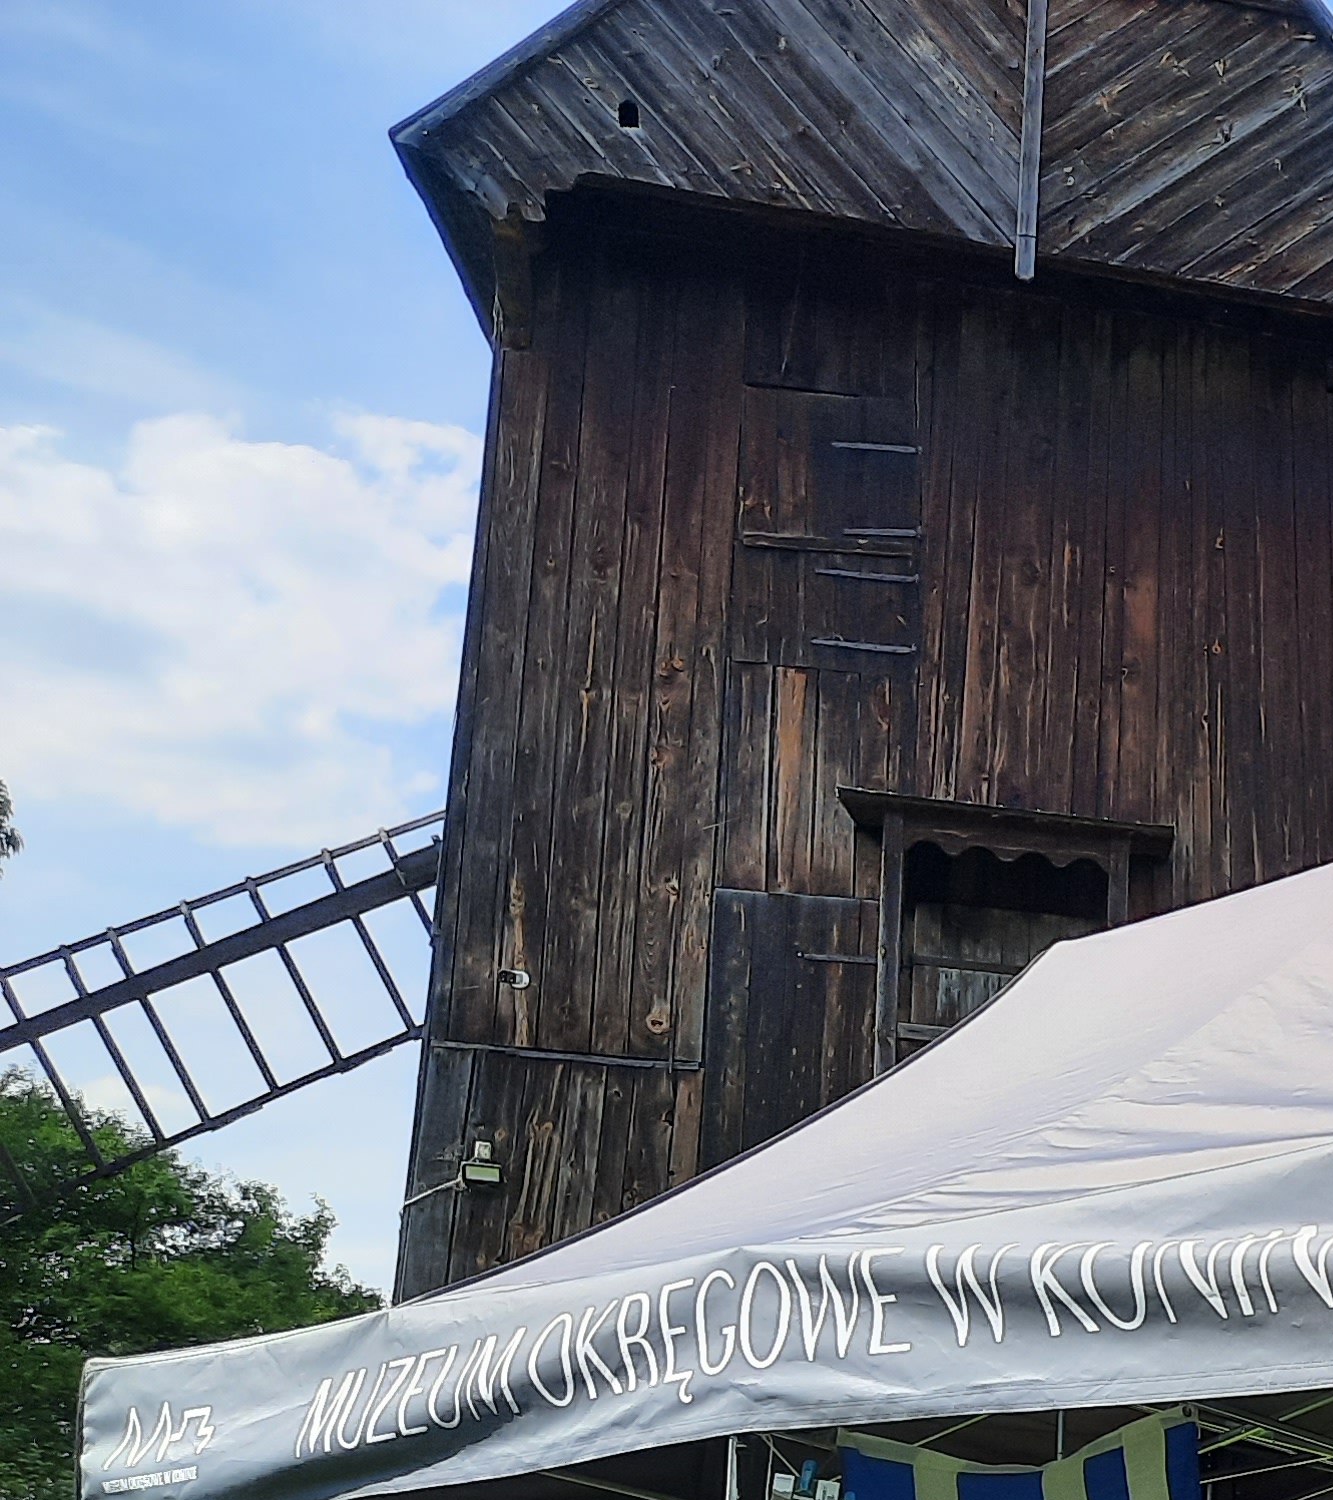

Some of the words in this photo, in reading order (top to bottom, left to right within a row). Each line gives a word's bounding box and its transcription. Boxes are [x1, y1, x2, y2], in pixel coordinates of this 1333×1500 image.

[294, 1326, 528, 1459] MUZEUM
[528, 1247, 912, 1406] OKRĘGOWE
[926, 1243, 1022, 1348] W
